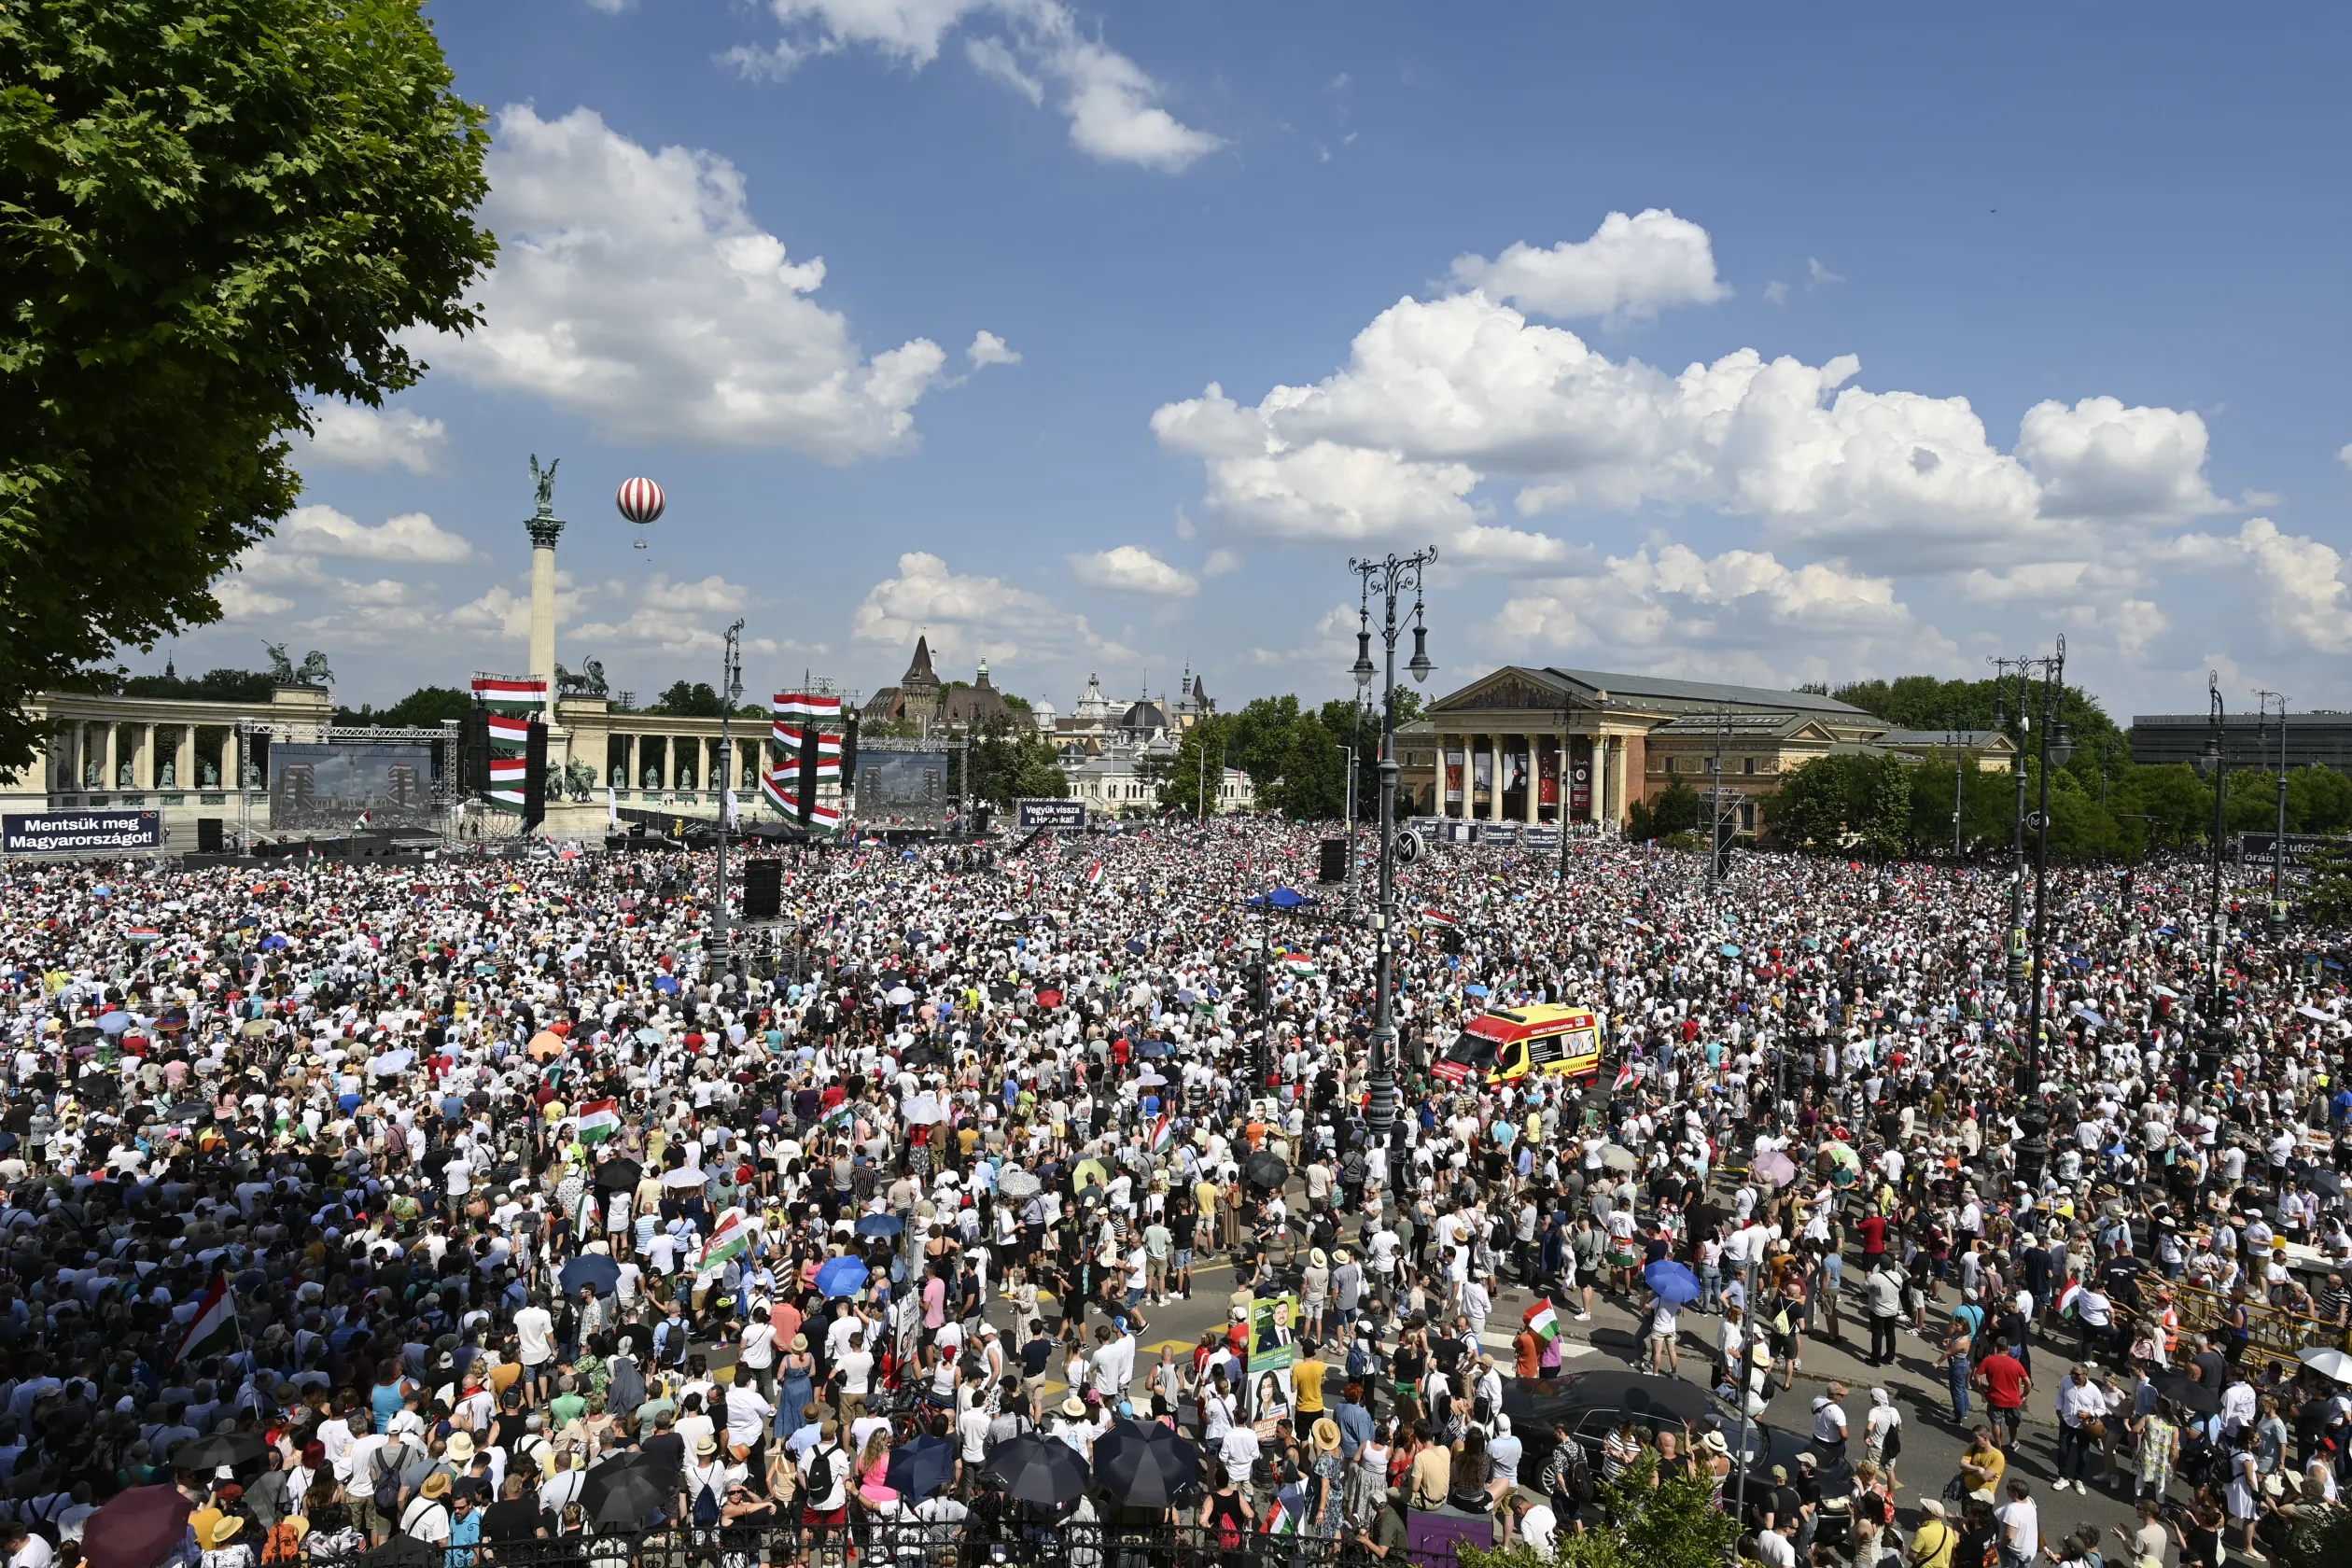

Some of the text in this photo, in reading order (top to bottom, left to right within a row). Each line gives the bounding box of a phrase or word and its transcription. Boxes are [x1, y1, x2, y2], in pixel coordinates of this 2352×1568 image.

[1026, 805, 1055, 815] Vegyük
[24, 817, 139, 832] Mentsük meg
[10, 832, 152, 849] Magyarországot!
[2245, 851, 2289, 863] órábn
[1464, 1029, 1503, 1043] AMBULANCE
[1251, 1351, 1274, 1363] SOPRONI
[1274, 1345, 1292, 1355] TAMÁS
